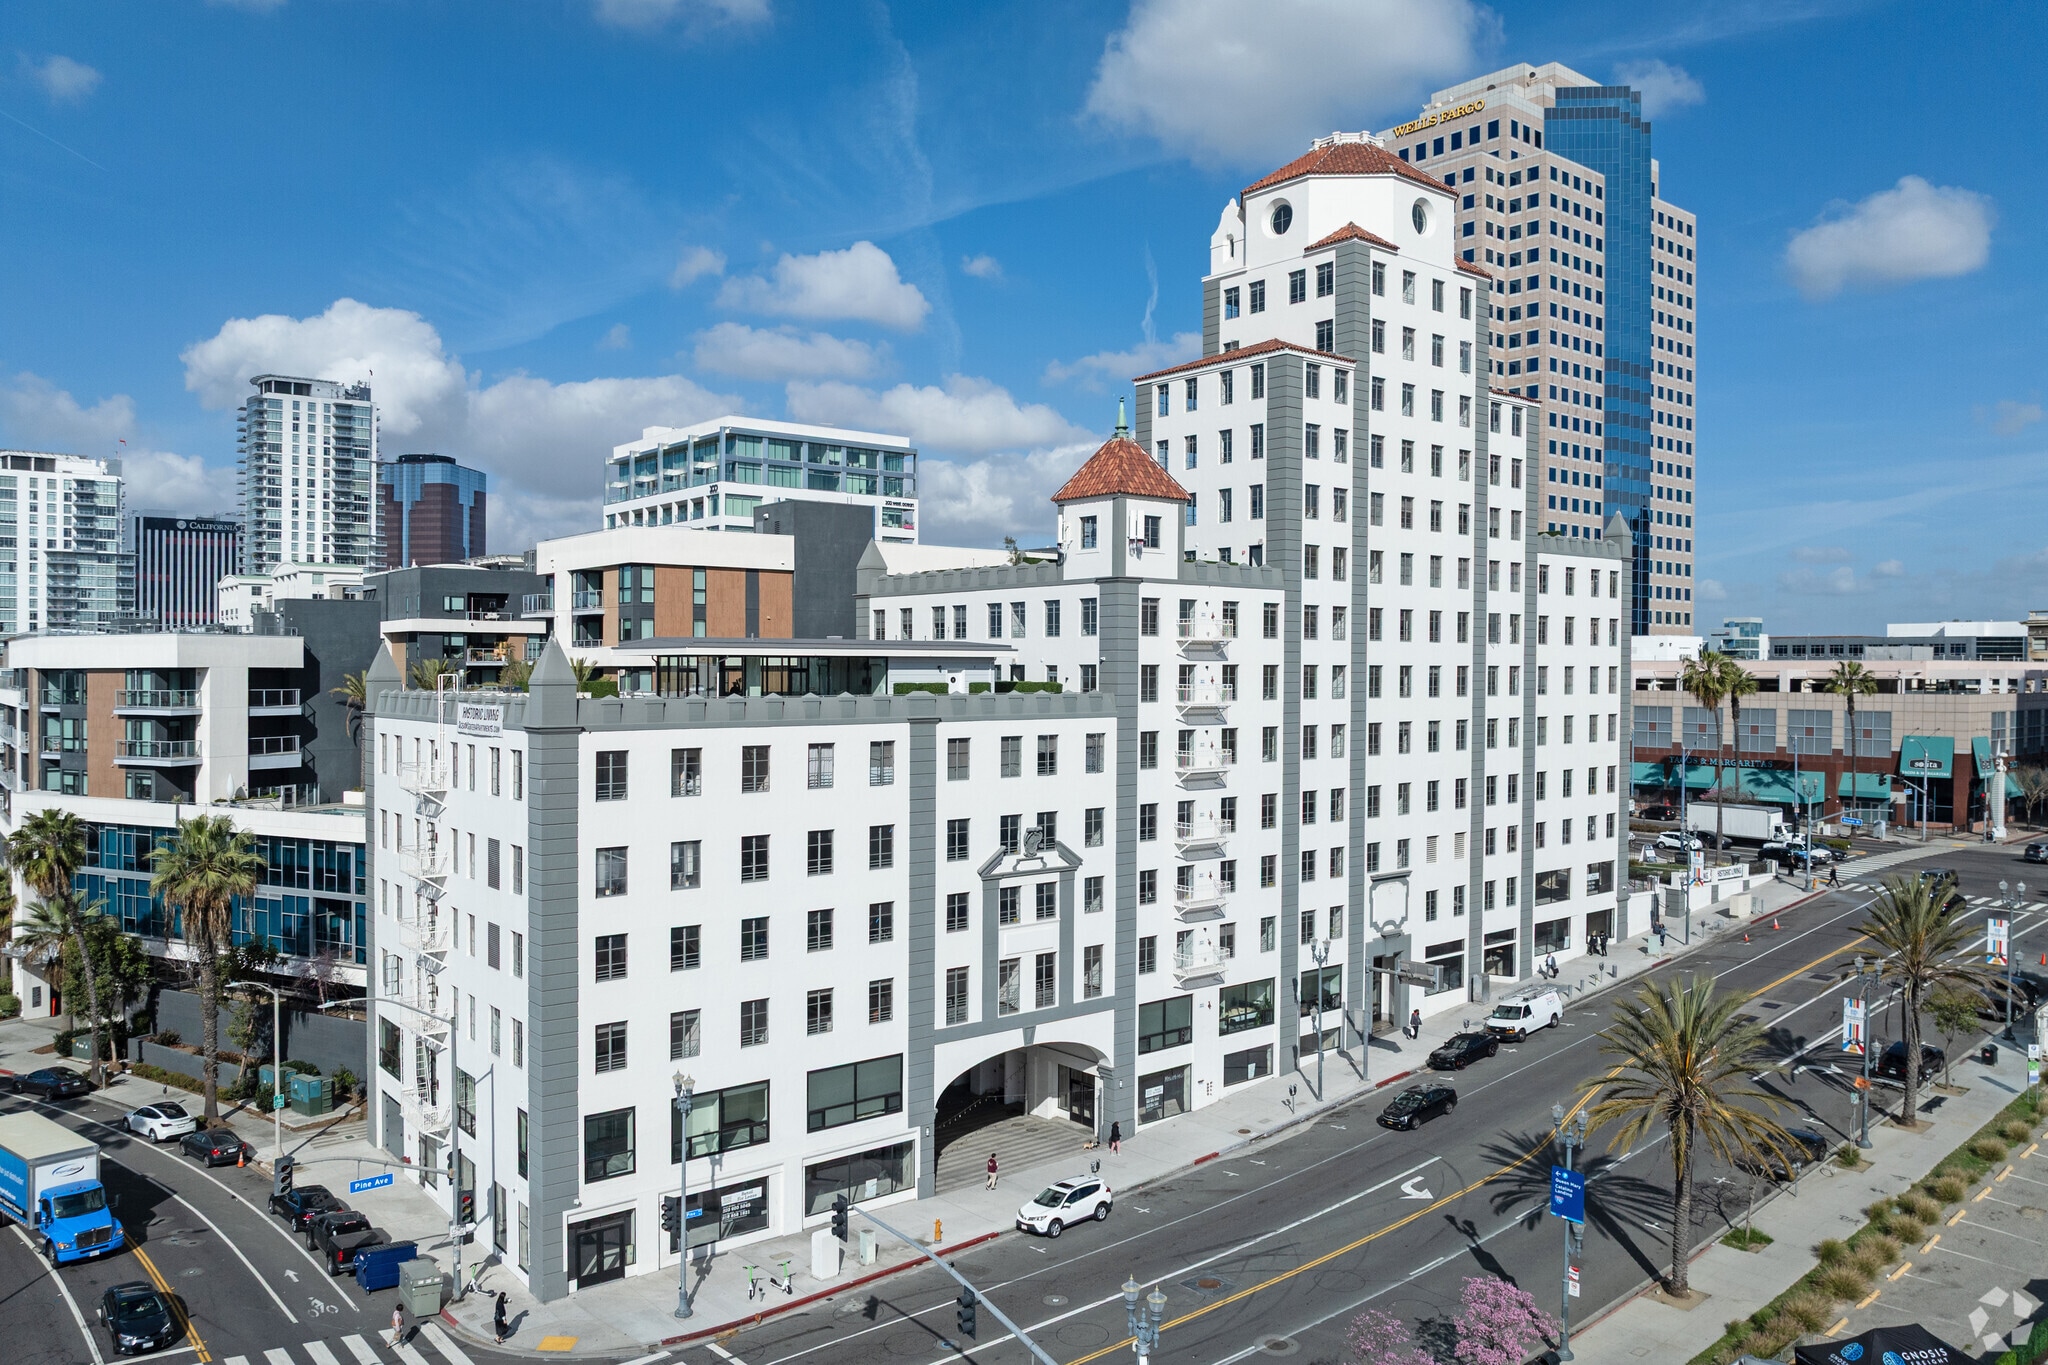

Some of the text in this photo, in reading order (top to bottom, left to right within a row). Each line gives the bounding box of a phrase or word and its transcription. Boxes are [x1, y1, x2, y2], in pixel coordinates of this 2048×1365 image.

[1393, 99, 1485, 138] WELLS FARGO
[189, 521, 238, 532] CALIFORNIA
[462, 706, 483, 720] HISTORIC
[1914, 760, 1938, 769] soita
[354, 1178, 389, 1190] Pine Ave
[1555, 1177, 1581, 1190] Queen Mary
[1555, 1183, 1573, 1193] Catalina
[1554, 1188, 1573, 1198] Landing
[1901, 1348, 1948, 1361] GNOSIS
